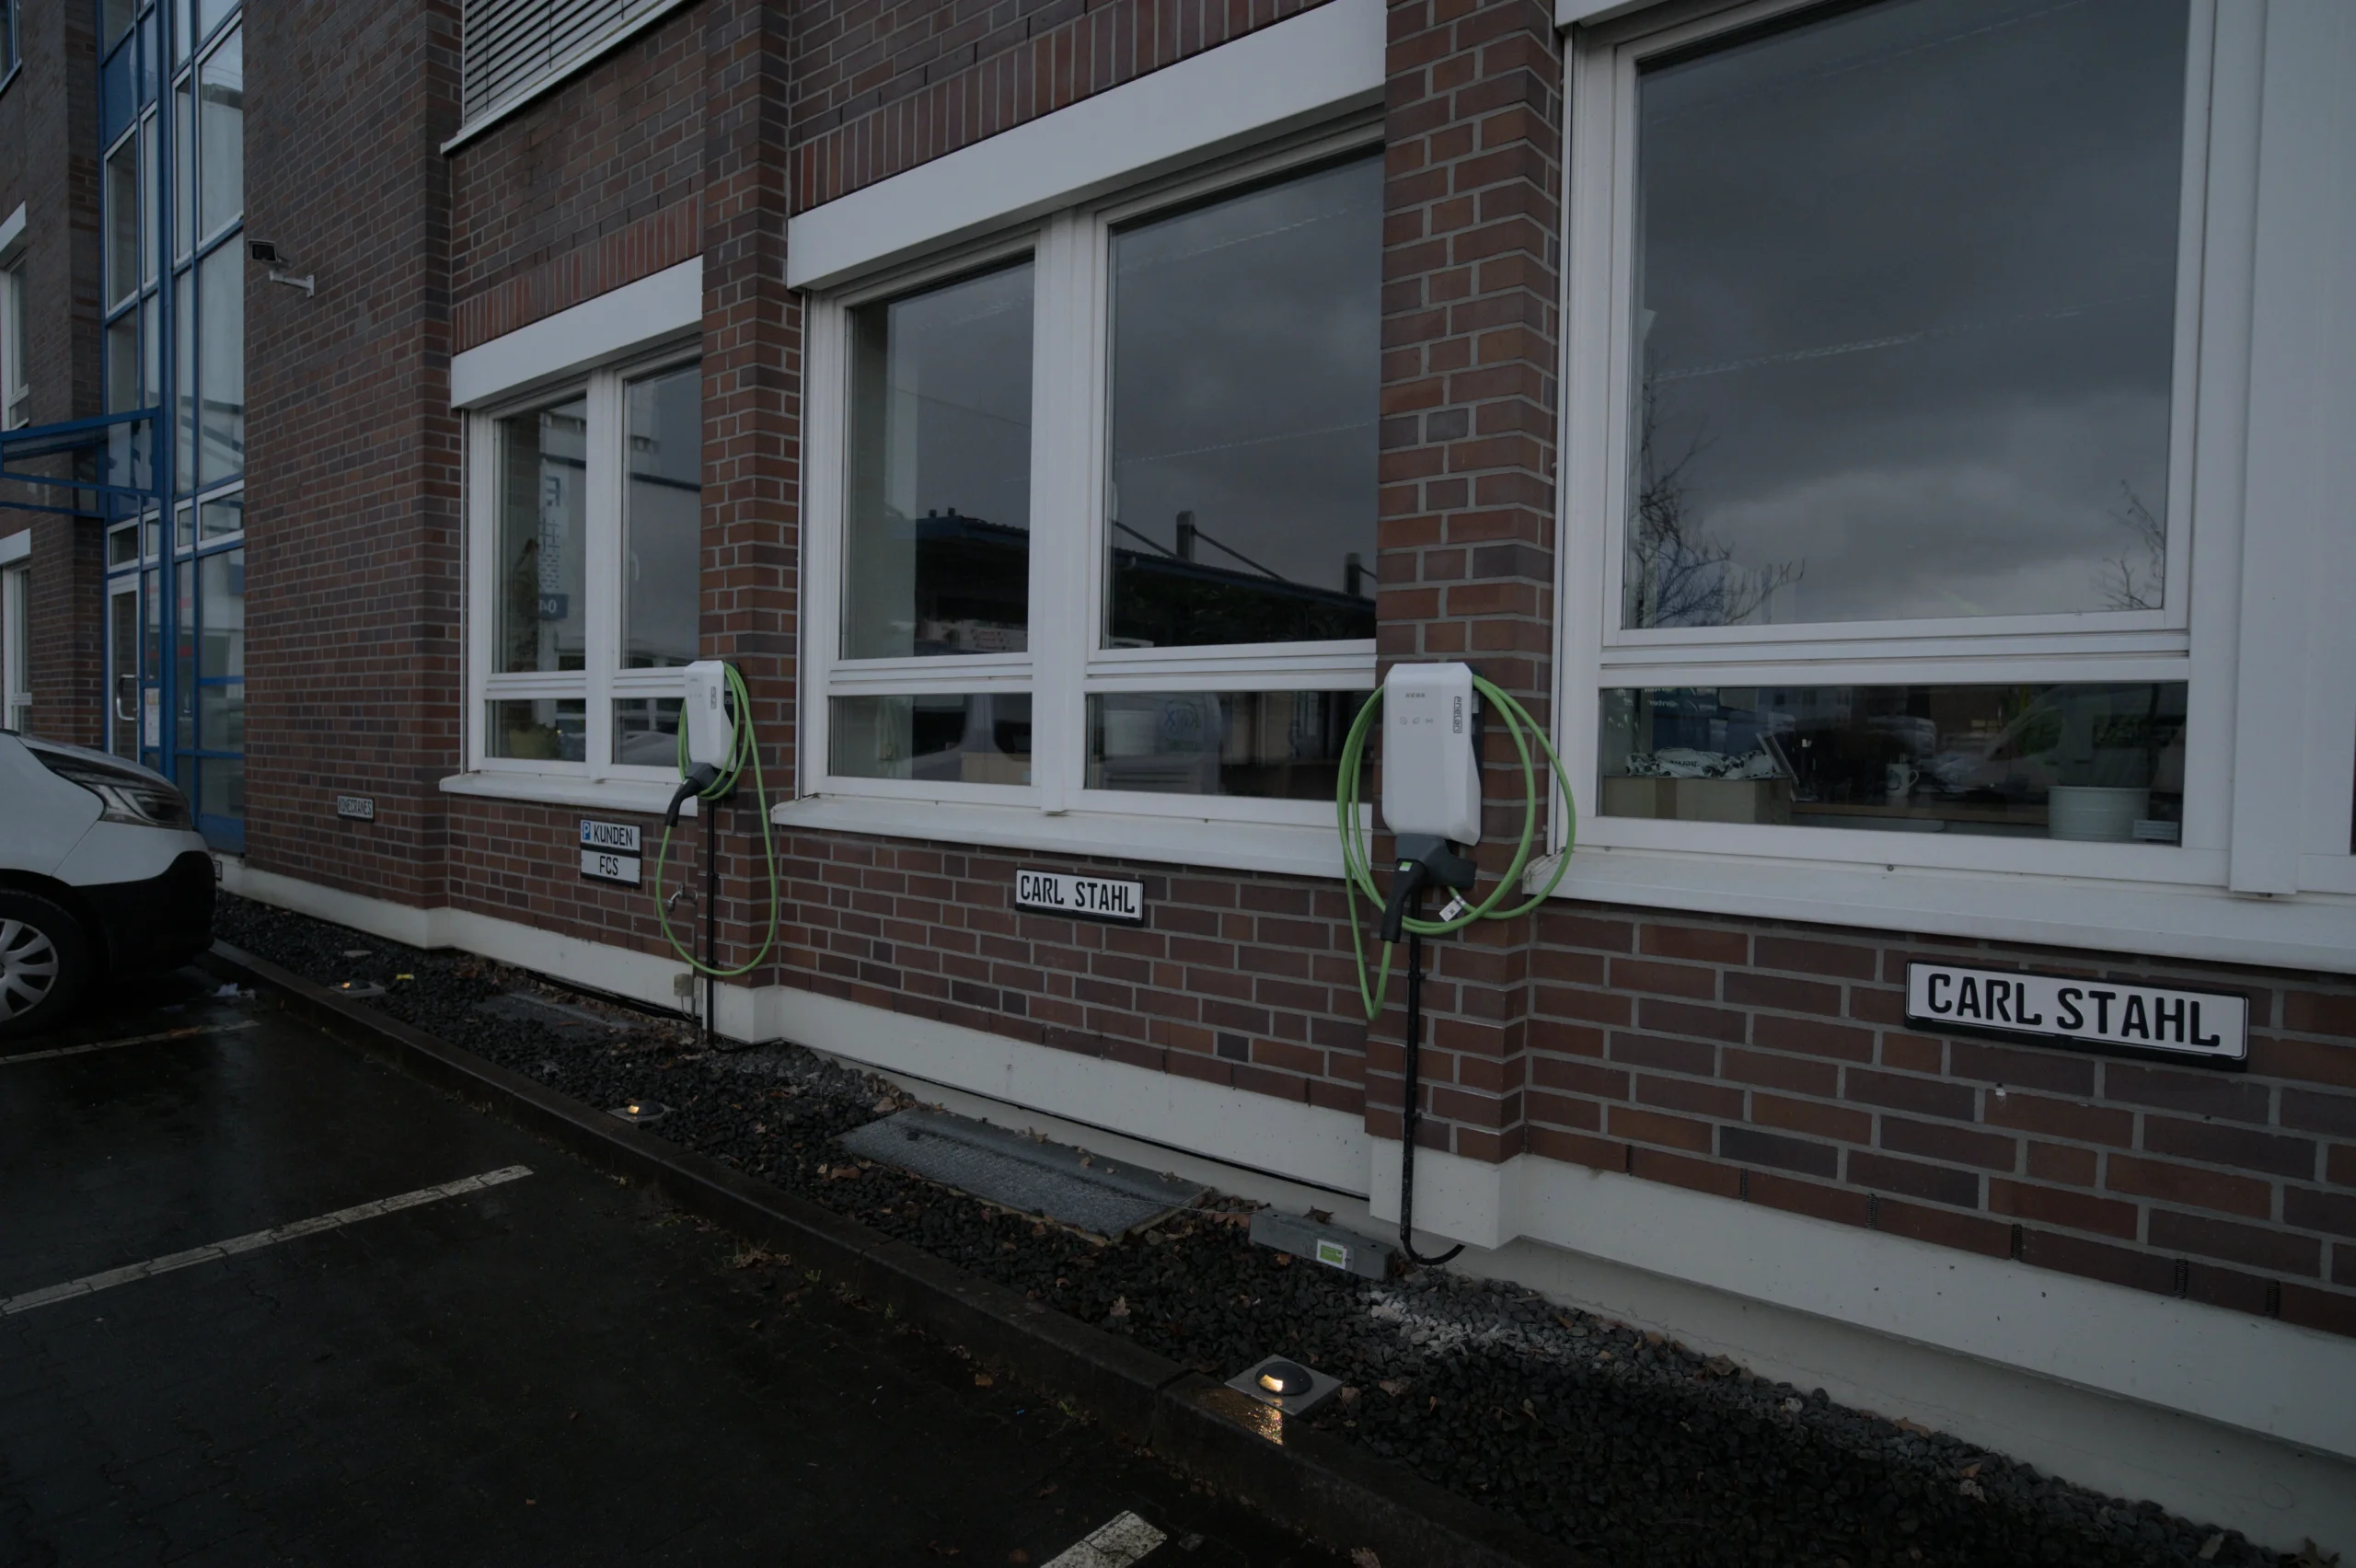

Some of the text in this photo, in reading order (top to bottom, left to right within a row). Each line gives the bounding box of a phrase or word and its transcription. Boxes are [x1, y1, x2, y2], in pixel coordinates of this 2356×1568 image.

[594, 824, 632, 847] KUNDEN
[599, 855, 618, 876] FCS
[1021, 875, 1135, 914] CARL STAHL
[1927, 973, 2221, 1047] CARL STAHL
